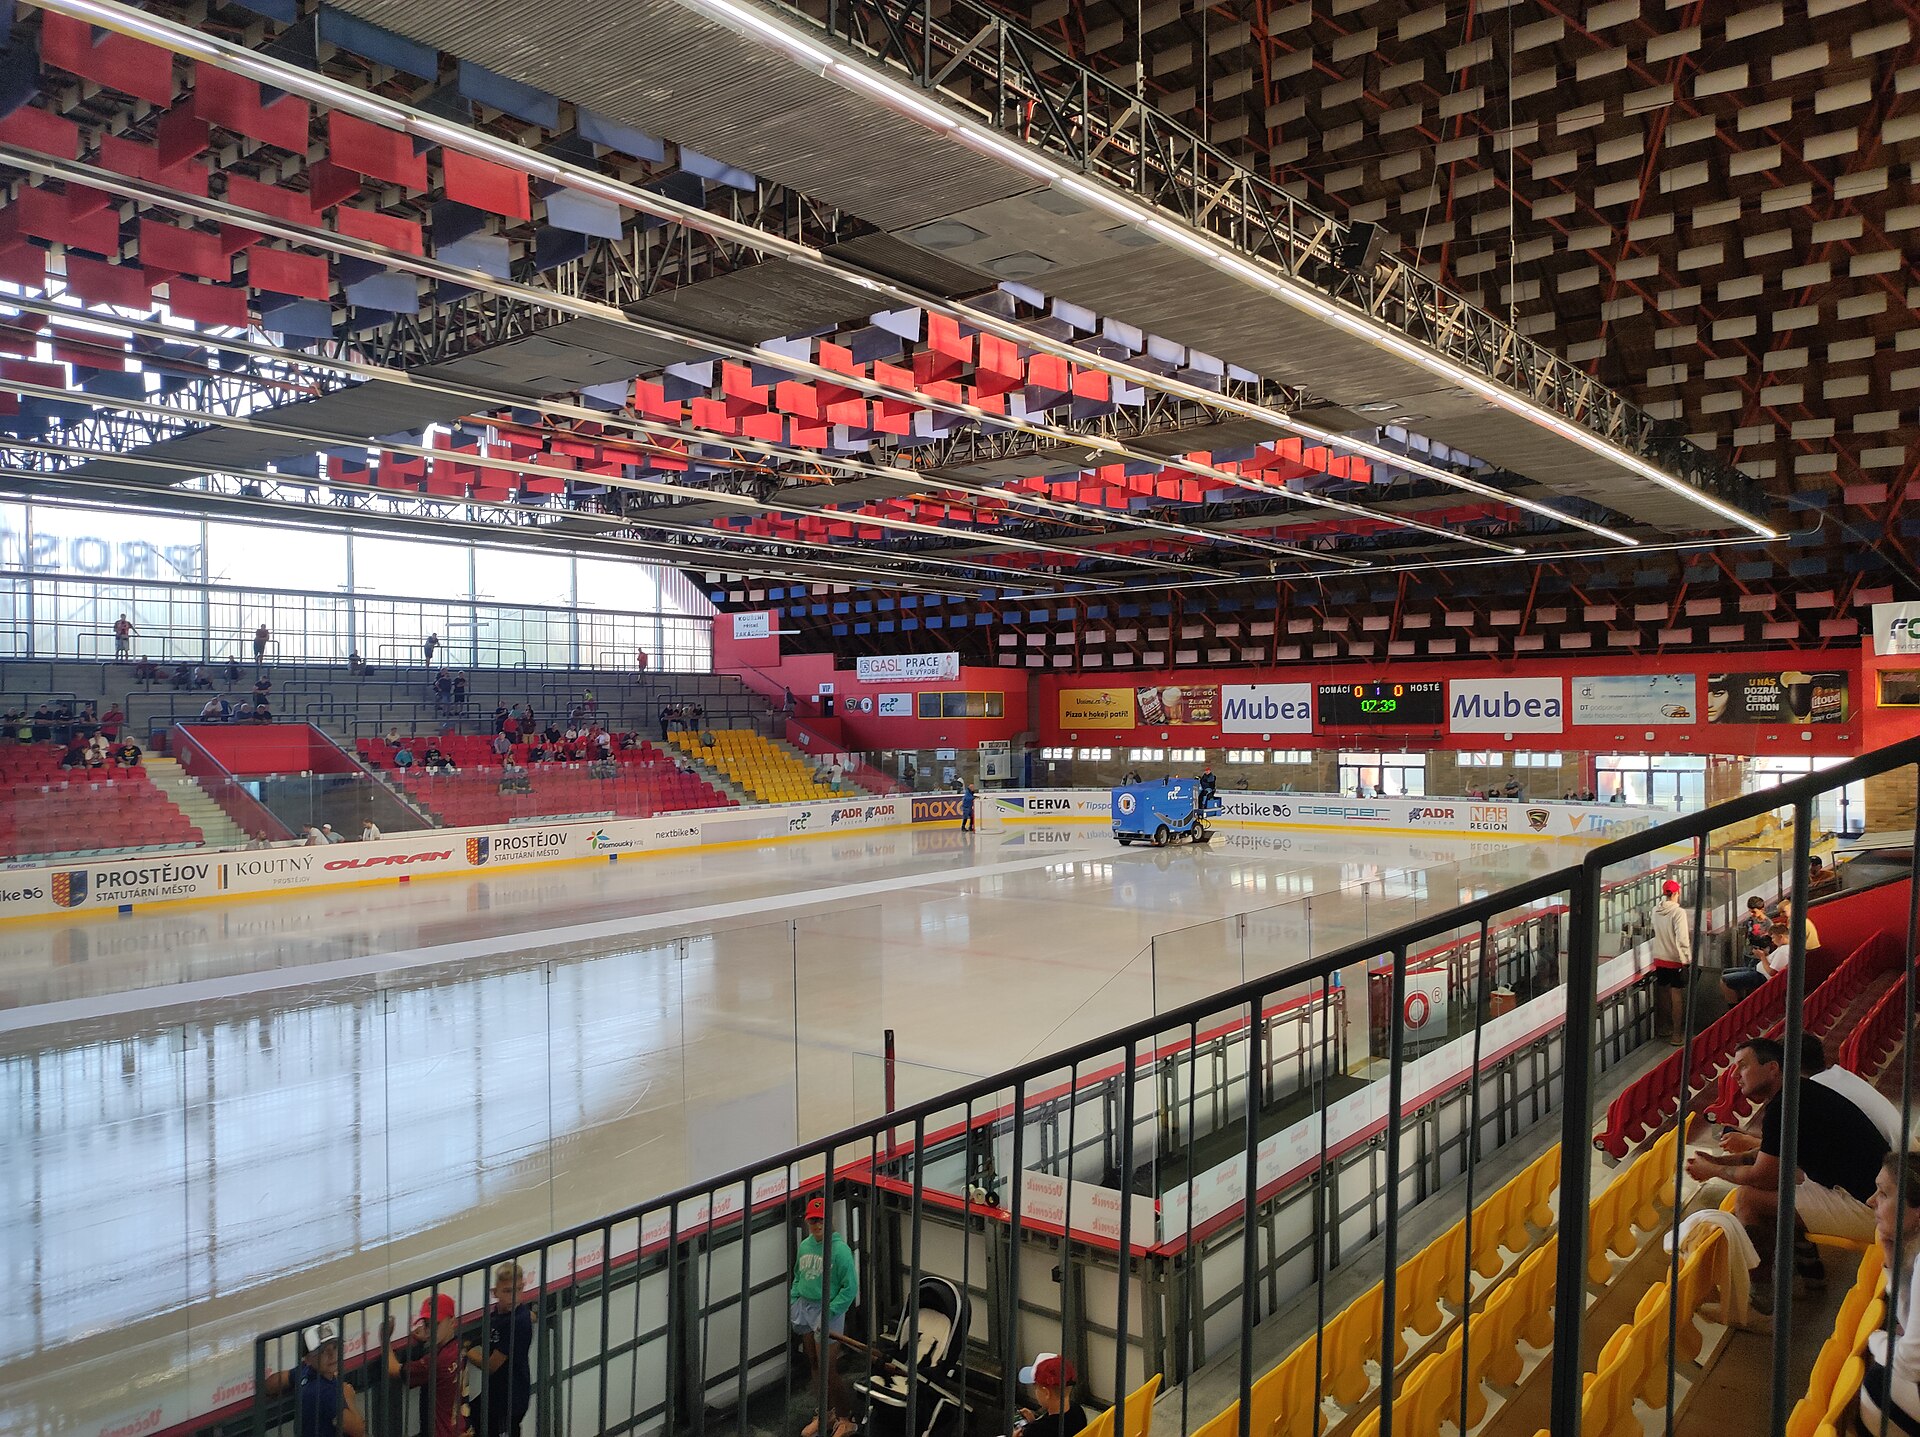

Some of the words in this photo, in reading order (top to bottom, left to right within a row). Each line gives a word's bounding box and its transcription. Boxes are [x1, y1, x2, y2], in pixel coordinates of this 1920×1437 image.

[870, 659, 902, 672] GASL
[905, 655, 939, 668] PRÁCE
[1757, 677, 1776, 686] NÁS
[1202, 688, 1218, 696] GÓL
[1319, 685, 1351, 694] DOMÁCÍ
[1354, 685, 1364, 698] 0
[1394, 684, 1404, 697] 0
[1410, 682, 1440, 692] HOSTÉ
[1744, 685, 1781, 695] DOZRÁL
[1188, 696, 1213, 705] ZLATÝ
[1453, 691, 1561, 717] Mubea
[1746, 694, 1777, 703] ČERNÝ
[1224, 694, 1311, 720] Mubea
[1746, 703, 1780, 711] CITRON
[1088, 711, 1108, 719] hokeji
[1029, 799, 1071, 809] CERVA
[1086, 802, 1112, 810] Tipspo
[1220, 802, 1271, 816] extbike
[841, 808, 862, 818] ADR
[875, 805, 895, 815] ADR
[1299, 806, 1391, 819] casper
[1423, 808, 1454, 818] ADR
[1470, 822, 1508, 831] REGION
[656, 828, 689, 839] nextbike
[494, 832, 567, 851] PROSTĚJOV
[598, 840, 633, 849] Olomoucký
[324, 851, 452, 871] OLPRAN
[494, 851, 535, 862] STATUTÁRNÍ
[236, 853, 314, 876] KOUTNÝ
[96, 863, 209, 888] PROSTĚJOV
[96, 888, 159, 902] STATUTÁRNÍ
[162, 884, 197, 895] MĚSTO
